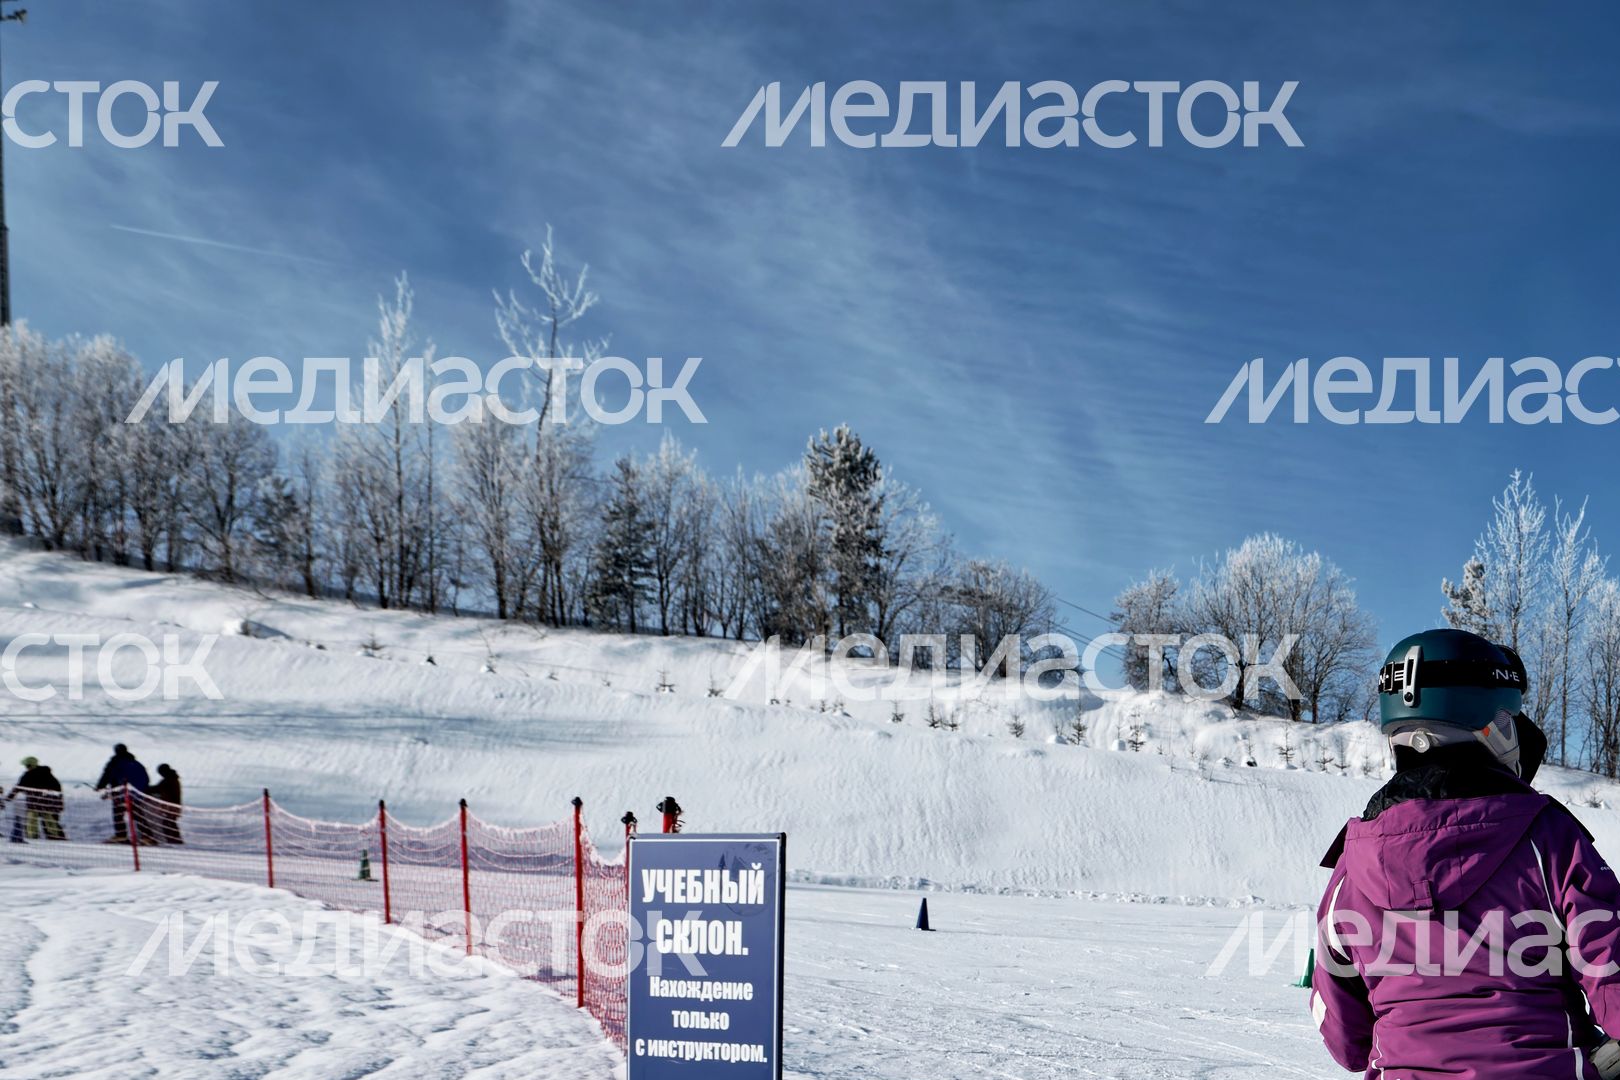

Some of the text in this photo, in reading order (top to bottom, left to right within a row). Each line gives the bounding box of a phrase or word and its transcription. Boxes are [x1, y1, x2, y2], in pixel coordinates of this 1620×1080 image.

[642, 863, 764, 904] УЧЕБНЫЙ
[656, 920, 749, 955] СКЛОН.
[650, 976, 753, 1001] Нахождение
[672, 1010, 729, 1030] только
[635, 1038, 767, 1063] с инструктором.
